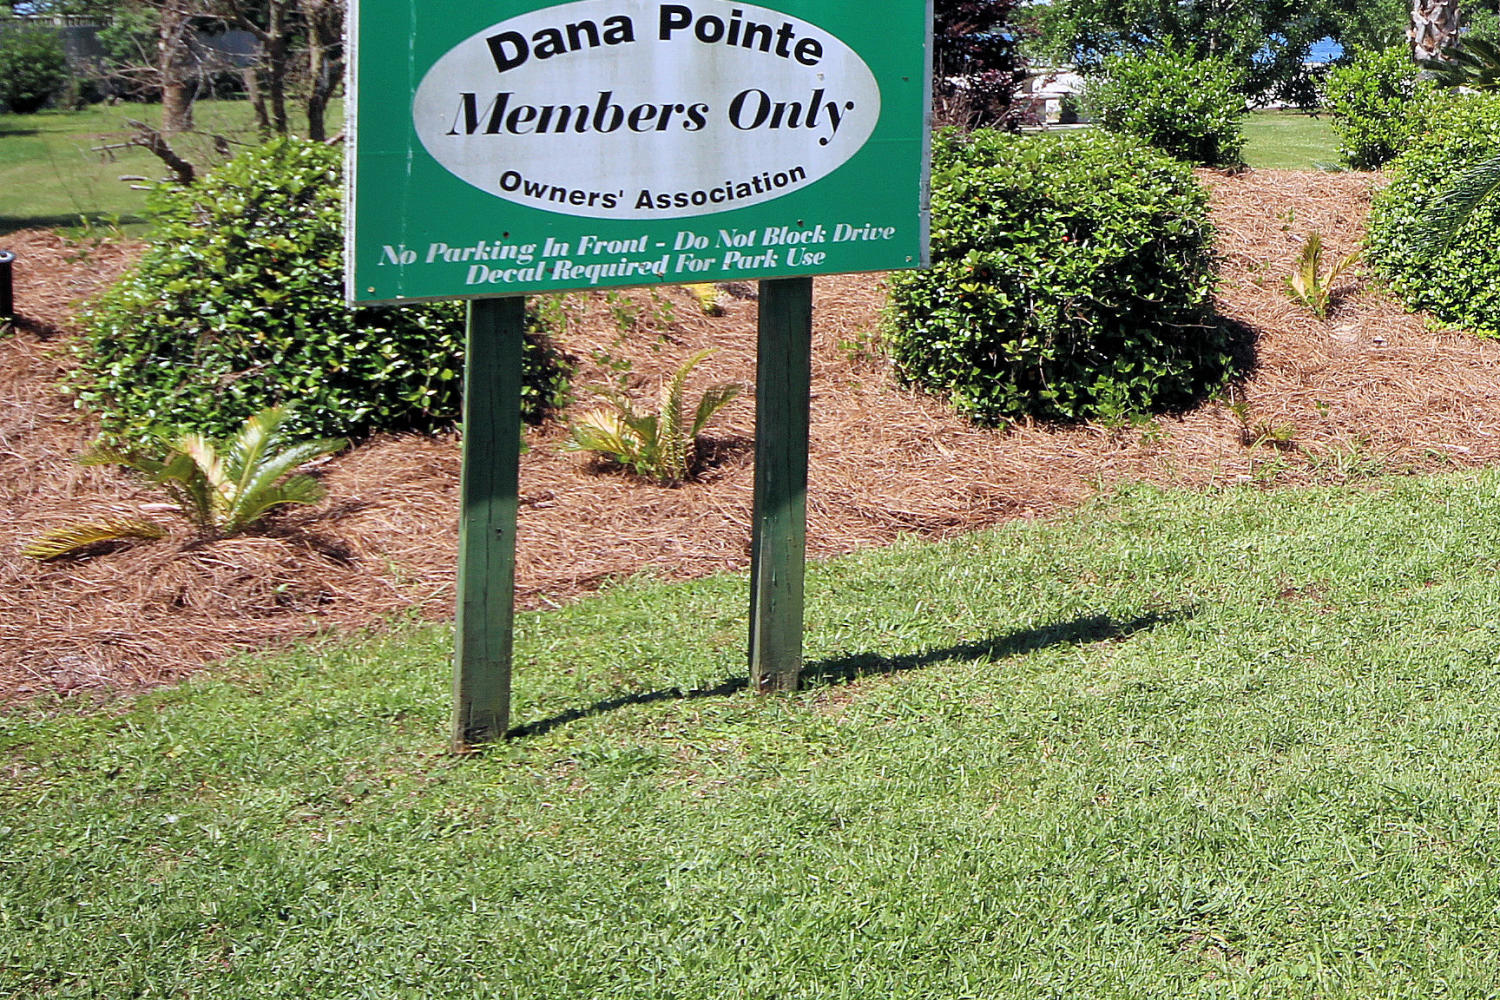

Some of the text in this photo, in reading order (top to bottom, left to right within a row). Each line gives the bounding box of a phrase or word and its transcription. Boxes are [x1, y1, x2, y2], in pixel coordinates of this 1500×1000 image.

[486, 4, 823, 73] Dana Pointe
[446, 88, 854, 146] Members Only
[499, 166, 806, 209] Owners' Association
[377, 245, 417, 266] No
[426, 240, 537, 265] Parking
[542, 237, 569, 258] In
[577, 235, 649, 256] Front
[674, 231, 709, 250] Do
[715, 229, 757, 248] Not
[762, 226, 826, 246] Block
[833, 223, 896, 242] Drive
[466, 247, 826, 285] Decal Required For Park Use
